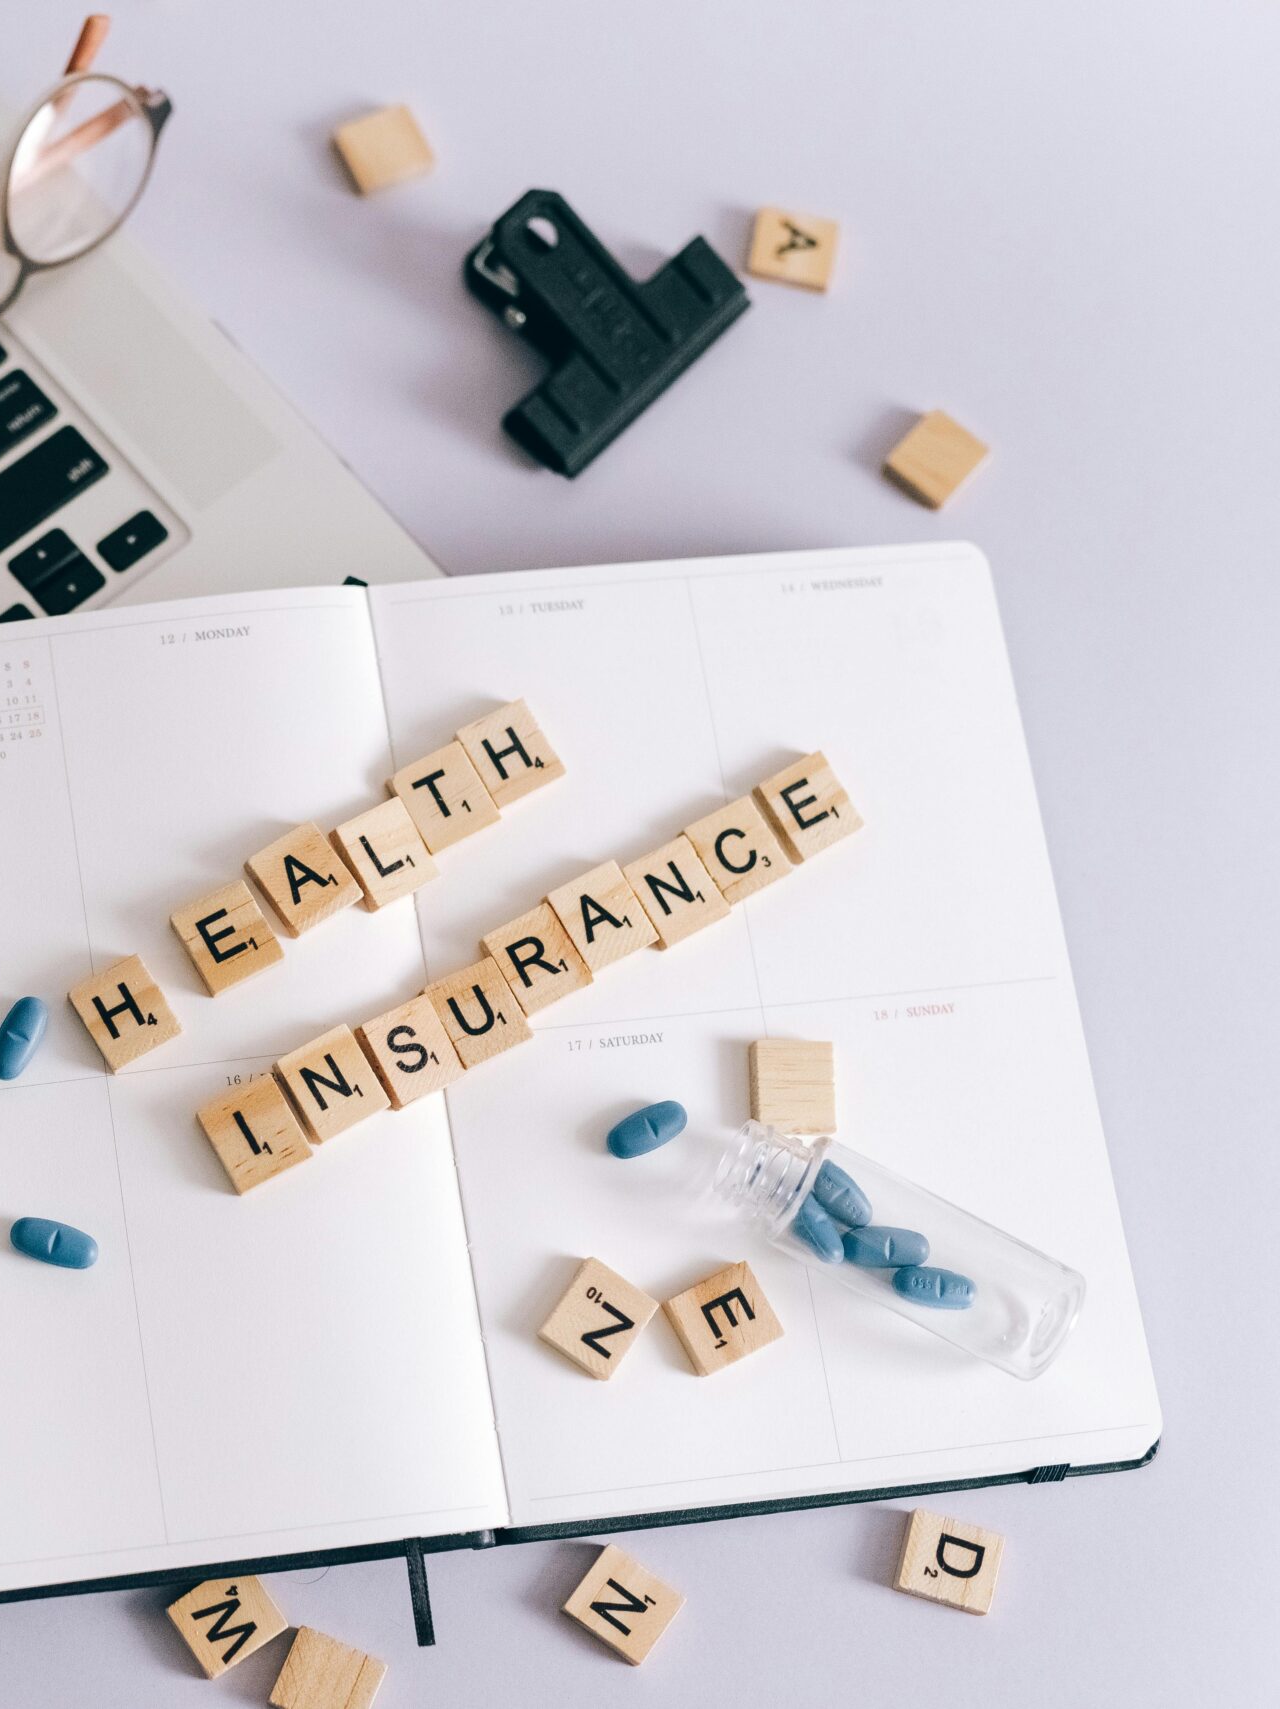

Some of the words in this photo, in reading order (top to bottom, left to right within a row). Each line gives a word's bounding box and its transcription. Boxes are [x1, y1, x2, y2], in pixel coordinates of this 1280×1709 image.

[777, 220, 818, 254] A
[811, 577, 883, 591] WEDNESDAY
[530, 599, 584, 614] TUESDAY
[160, 633, 176, 645] 12
[195, 625, 250, 642] MONDAY
[4, 662, 11, 672] S
[23, 660, 30, 669] S
[7, 680, 13, 689] 3
[25, 678, 32, 686] 4
[6, 697, 18, 706] 10
[25, 694, 37, 704] 11
[8, 714, 20, 723] 17
[27, 711, 40, 721] 18
[10, 731, 22, 741] 24
[29, 728, 42, 738] 25
[533, 756, 545, 770] 4
[461, 799, 472, 813] 1
[829, 806, 840, 819] 1
[404, 854, 415, 868] 1
[761, 855, 772, 868] 3
[327, 873, 339, 886] 1
[695, 890, 705, 904] 1
[621, 915, 633, 928] 1
[248, 937, 259, 950] 1
[233, 777, 830, 1156] INSURANCE
[558, 958, 569, 972] 1
[145, 1012, 158, 1026] 4
[496, 1010, 506, 1024] 1
[874, 1008, 889, 1020] 18
[906, 1004, 955, 1018] SUNDAY
[567, 1039, 582, 1051] 17
[599, 1032, 664, 1048] SATURDAY
[429, 1051, 440, 1065] 1
[227, 1074, 241, 1086] 16
[353, 1084, 364, 1098] 1
[262, 1141, 272, 1155] 1
[586, 1286, 603, 1304] 10
[700, 1286, 756, 1338] E
[582, 1301, 635, 1359] Z
[714, 1338, 728, 1349] 1
[936, 1533, 985, 1578] D
[924, 1566, 938, 1578] 2
[225, 1585, 238, 1596] 4
[644, 1594, 656, 1605] 1
[590, 1578, 648, 1636] N
